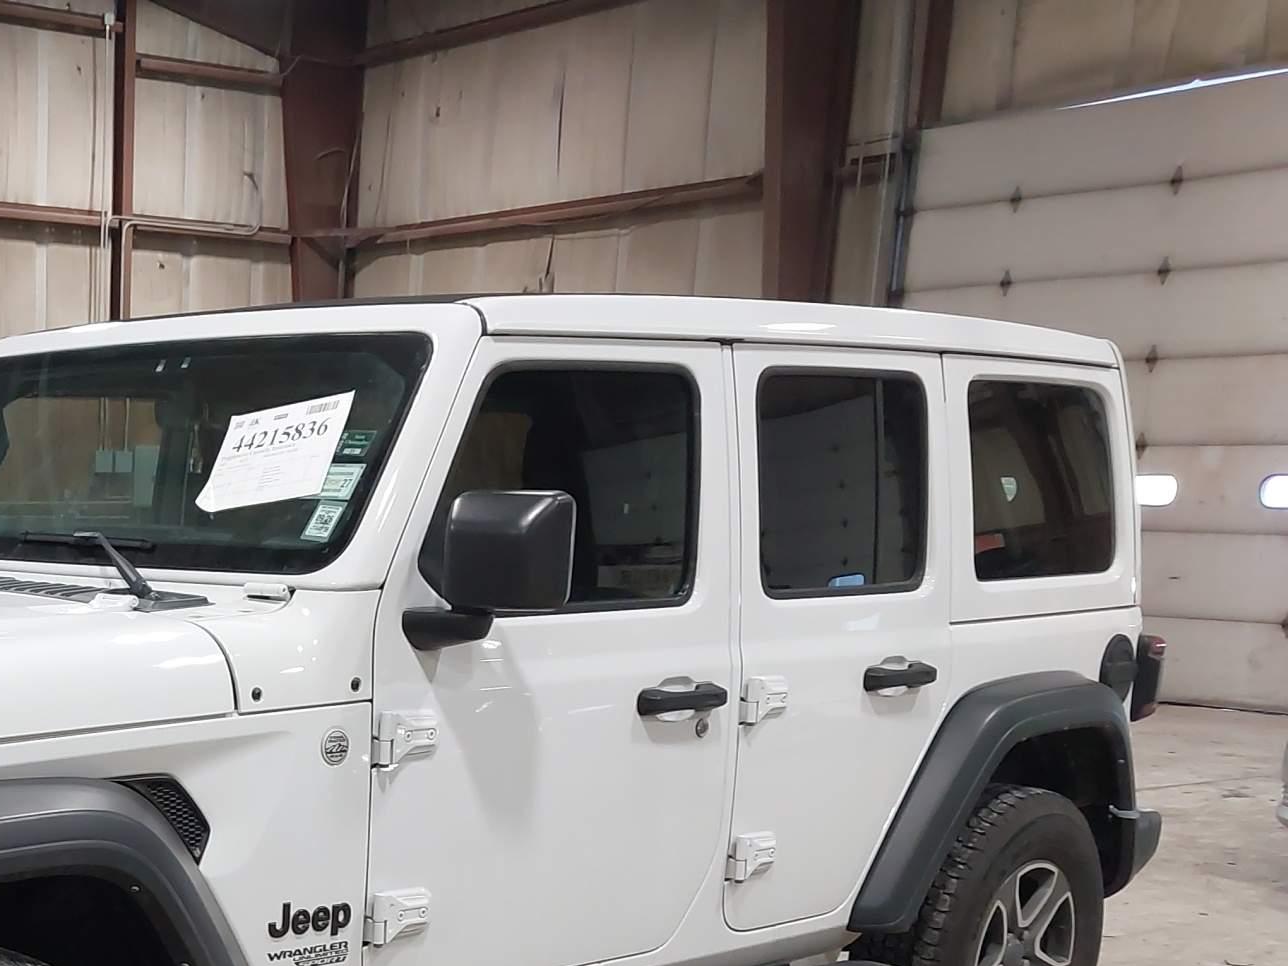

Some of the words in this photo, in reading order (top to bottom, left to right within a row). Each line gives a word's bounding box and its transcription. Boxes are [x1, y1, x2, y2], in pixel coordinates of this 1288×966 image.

[231, 416, 331, 453] 44215836
[267, 901, 352, 939] Jeep
[266, 940, 349, 962] WRANGLER
